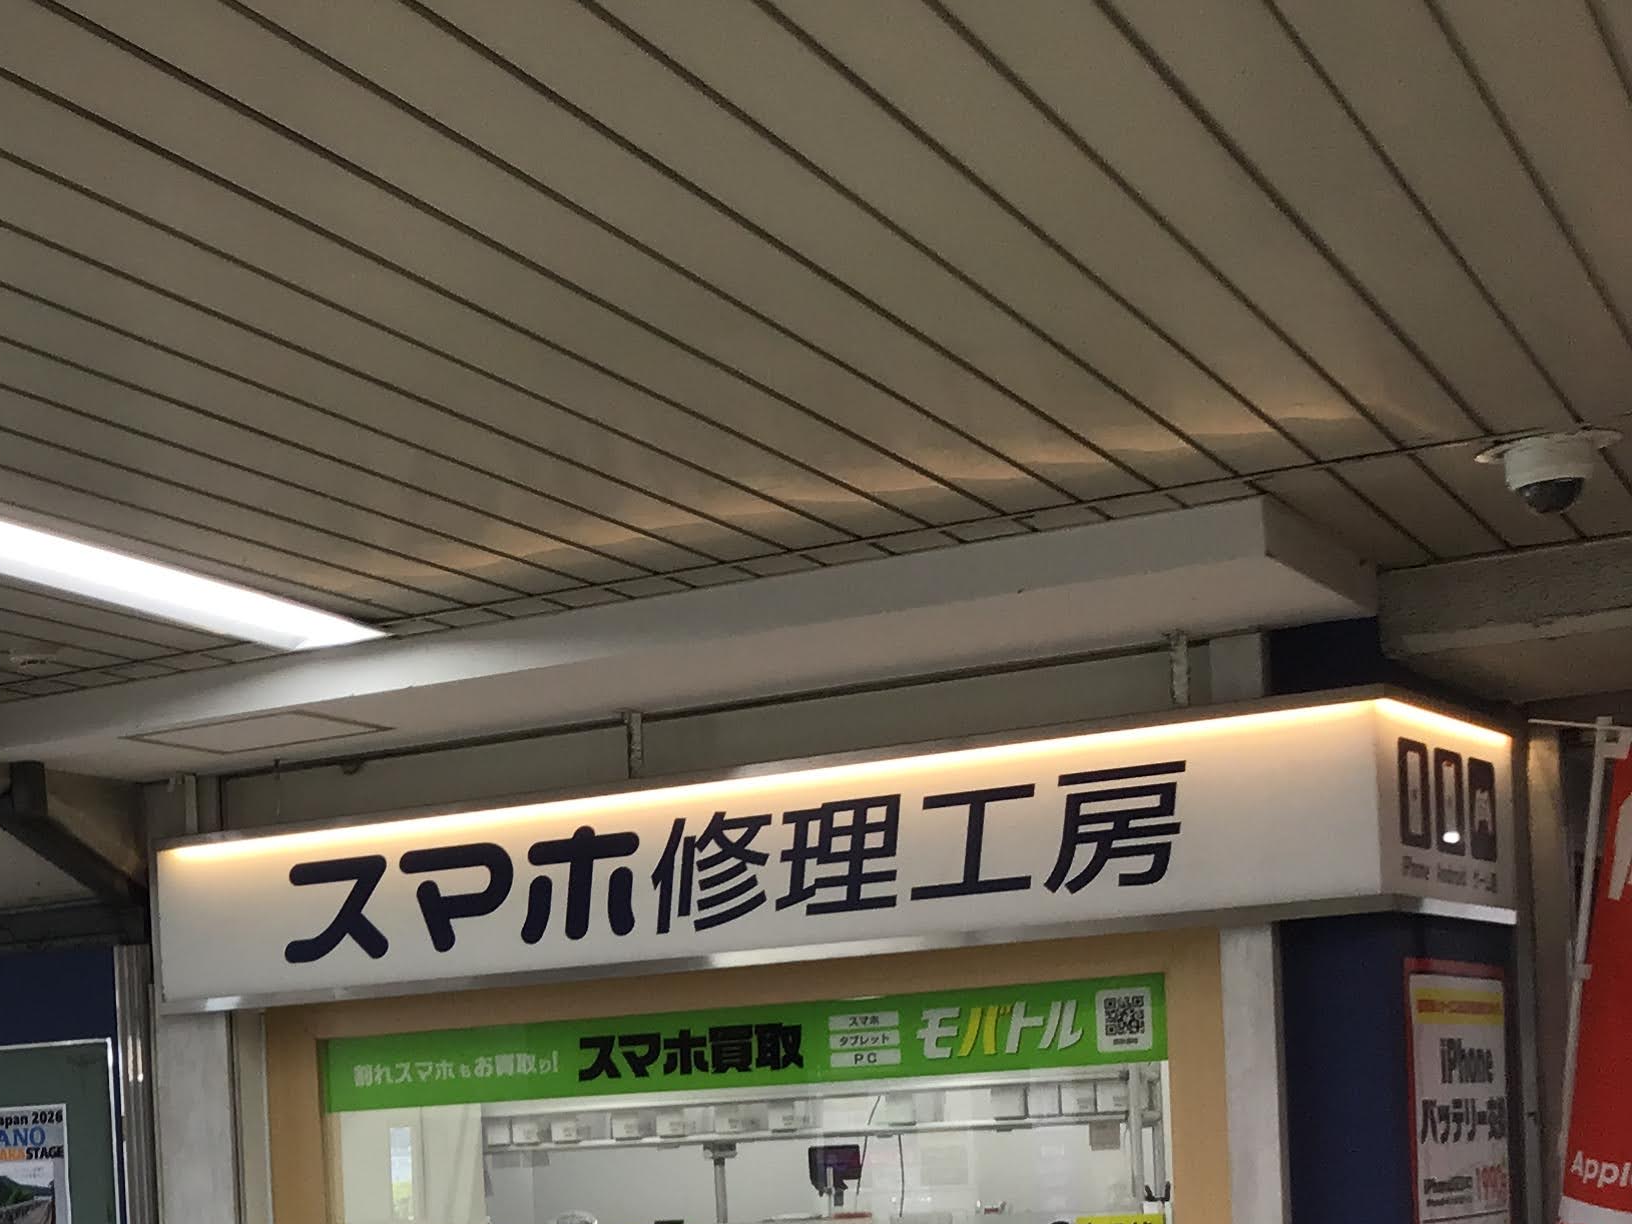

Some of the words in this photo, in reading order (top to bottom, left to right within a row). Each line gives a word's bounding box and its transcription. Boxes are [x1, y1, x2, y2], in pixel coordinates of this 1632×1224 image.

[285, 760, 1186, 963] スマホ修理工房
[848, 1015, 880, 1027] スマホ
[916, 999, 1084, 1060] モバトル
[839, 1033, 890, 1047] タブレット
[578, 1022, 804, 1082] スマホ買取
[854, 1052, 878, 1065] PC
[31, 1109, 64, 1124] 2026
[26, 1145, 65, 1160] STAGE
